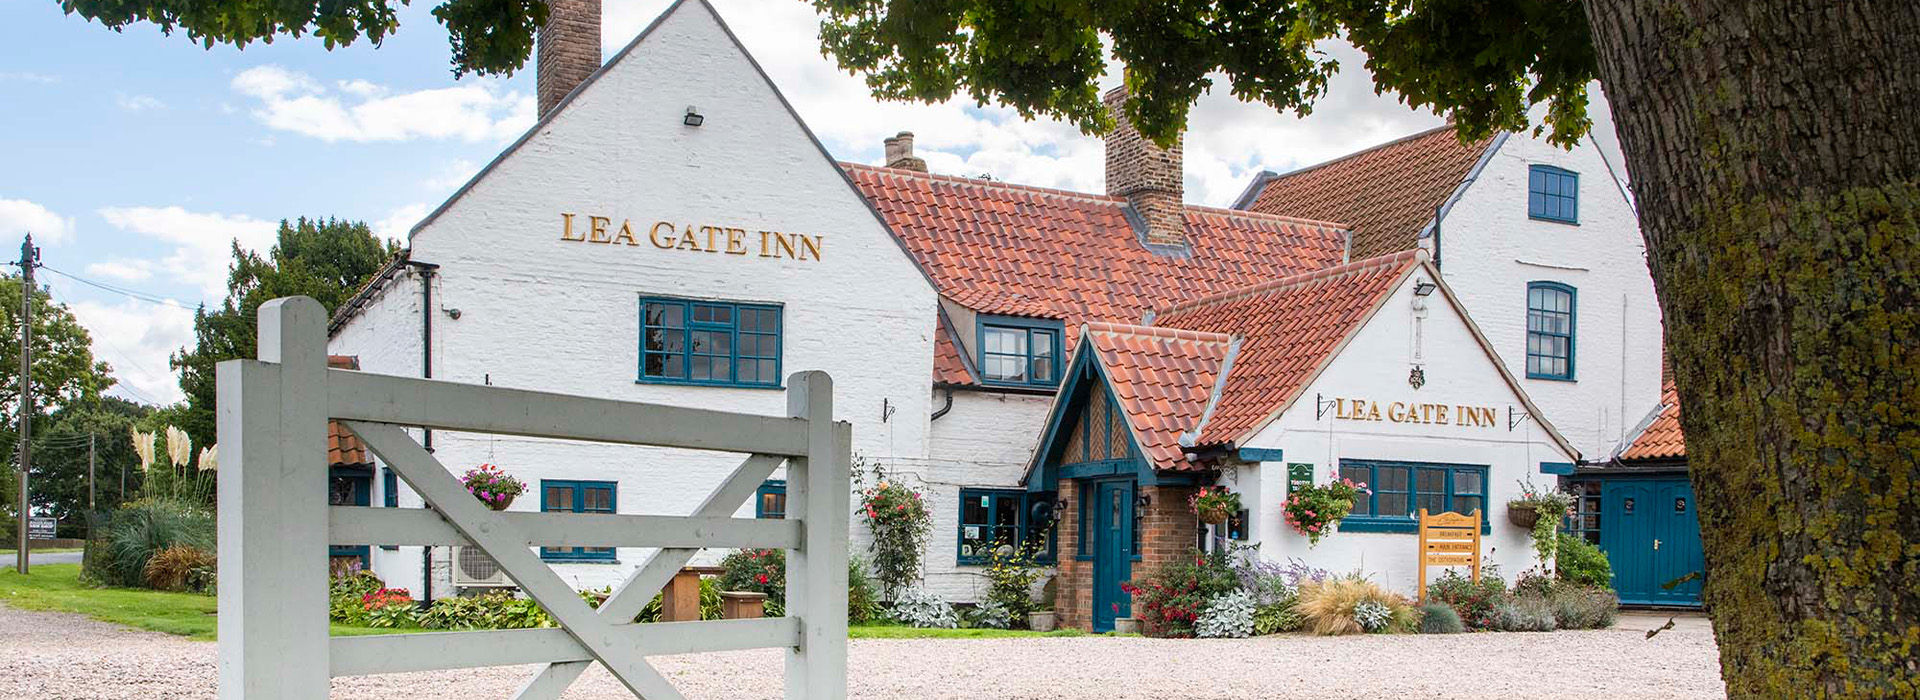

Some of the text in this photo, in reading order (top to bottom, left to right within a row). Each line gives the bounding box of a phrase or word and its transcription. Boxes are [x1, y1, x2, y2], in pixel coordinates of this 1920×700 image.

[560, 213, 824, 262] LEA GATE INN
[1335, 397, 1497, 427] LEA GATE INN
